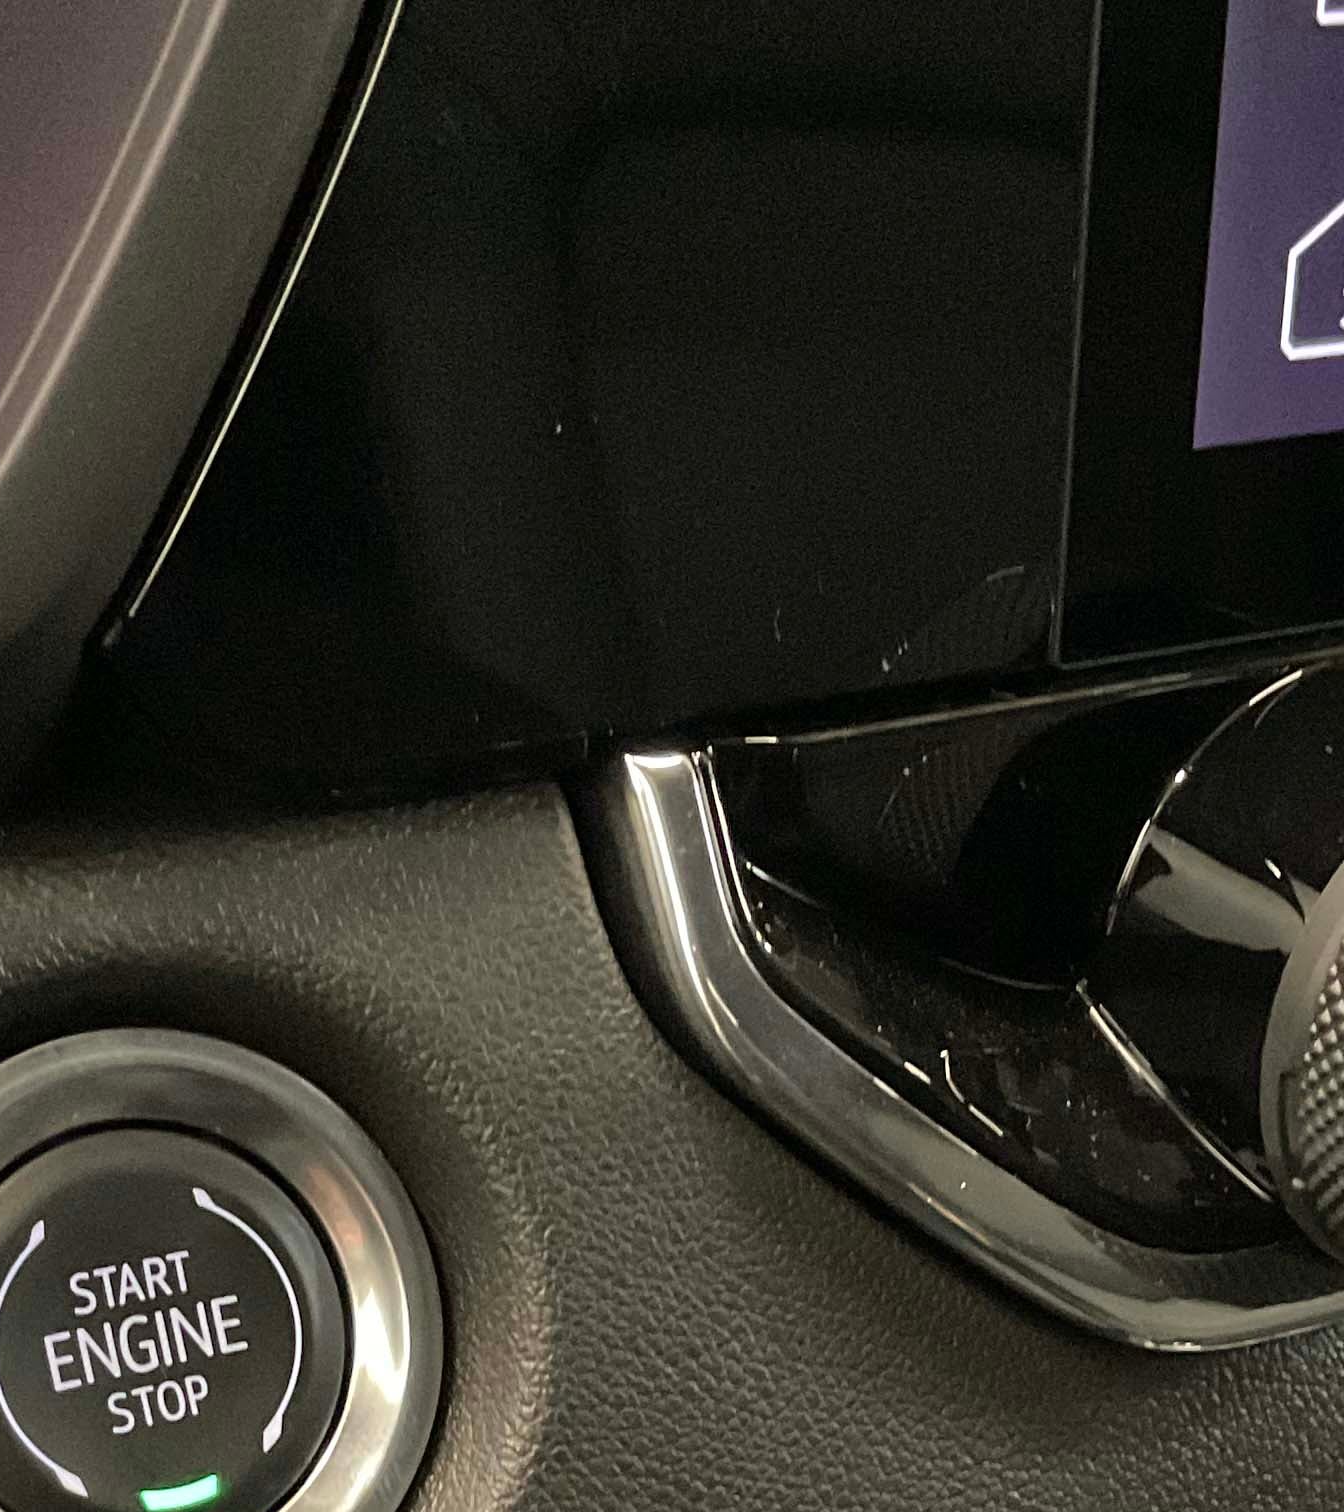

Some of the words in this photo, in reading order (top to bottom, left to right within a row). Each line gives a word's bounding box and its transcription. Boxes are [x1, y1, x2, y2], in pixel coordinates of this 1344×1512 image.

[69, 1250, 190, 1316] START
[43, 1294, 249, 1392] ENGINE
[106, 1374, 209, 1434] STOP
